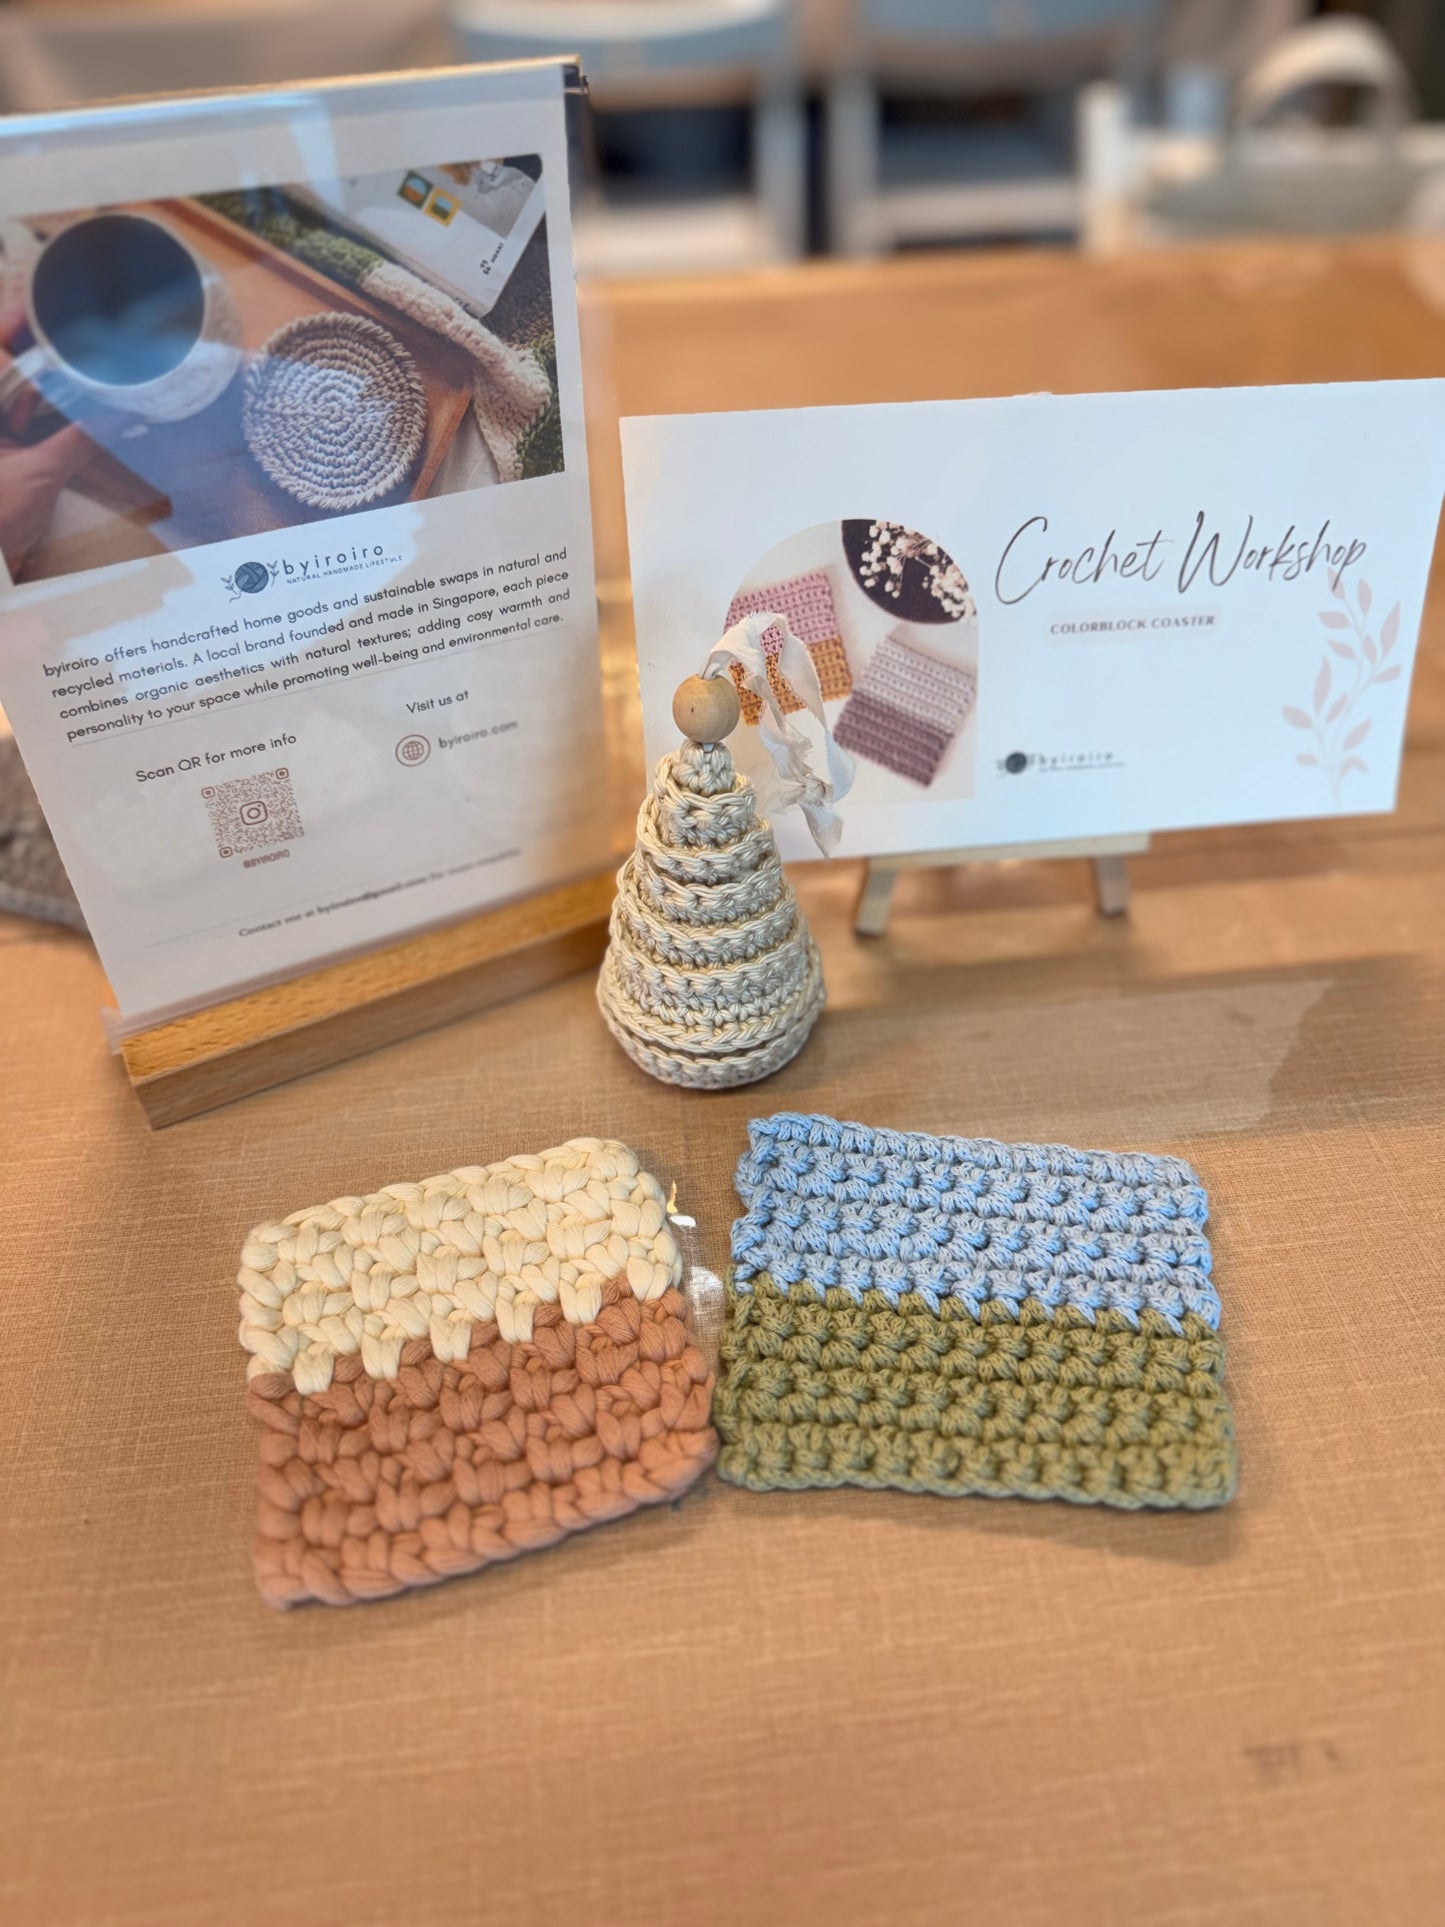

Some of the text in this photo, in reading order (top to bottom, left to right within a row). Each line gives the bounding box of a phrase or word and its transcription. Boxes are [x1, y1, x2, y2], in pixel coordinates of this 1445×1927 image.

[283, 545, 384, 576] byiroiro
[286, 572, 321, 584] NATURAL
[323, 564, 364, 577] HANDMADE
[995, 510, 1367, 605] Crochet Workshop
[43, 547, 568, 678] byiroiro offers handcrafted home goods and sustainable swaps in natural and
[52, 571, 569, 698] recycled materials. A local brand founded and made in Singapore, each piece
[1050, 615, 1215, 635] COLORBLOCK COASTER
[60, 588, 570, 720] combines organic aesthetics with natural textures; adding cosy warmth and
[66, 614, 564, 742] personality to your space while promoting well-being and environmental care.
[406, 690, 470, 714] Visit us at
[136, 733, 297, 782] Scan QR for more info
